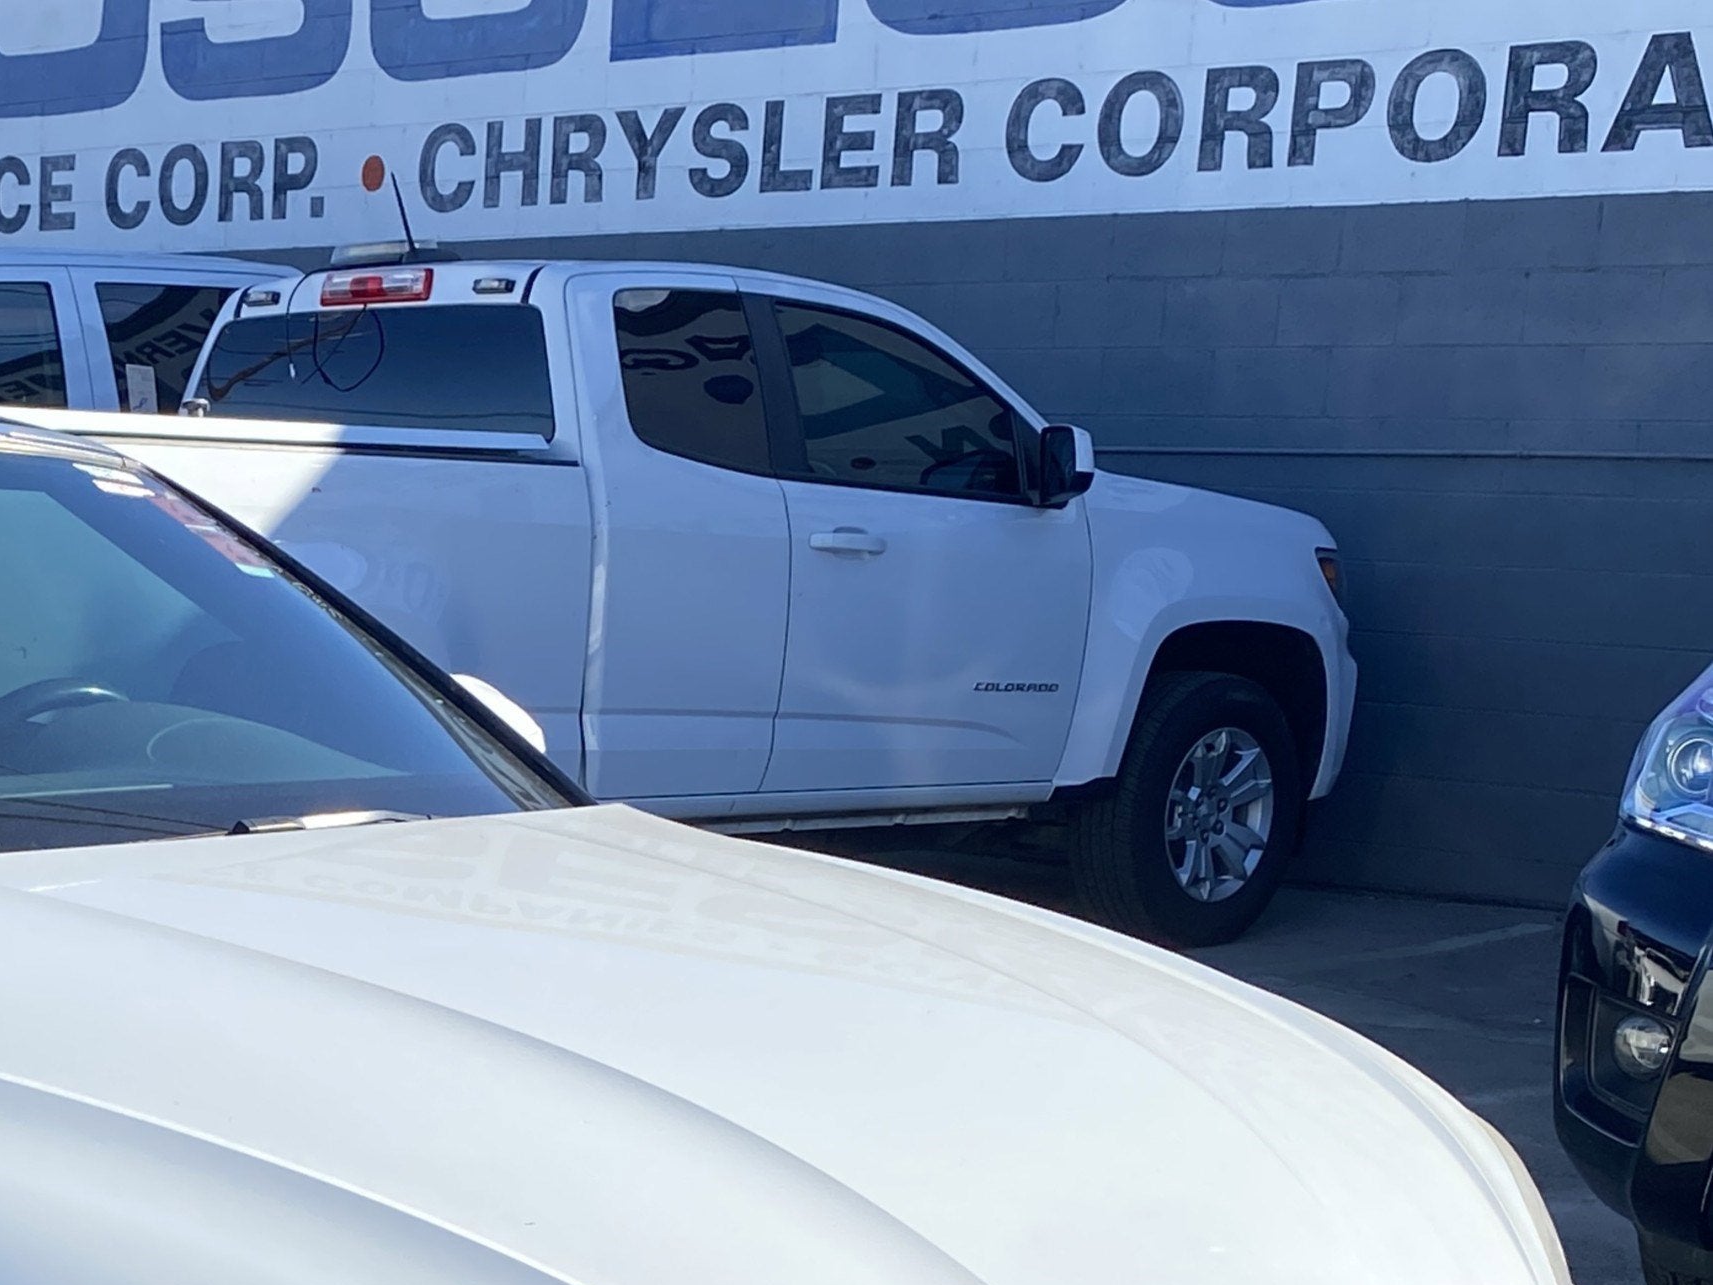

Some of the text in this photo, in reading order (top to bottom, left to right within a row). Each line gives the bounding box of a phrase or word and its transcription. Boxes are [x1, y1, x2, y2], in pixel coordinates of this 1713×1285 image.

[105, 135, 325, 230] CORP.
[418, 87, 964, 213] CHRYSLER
[973, 682, 1060, 693] COLORADO
